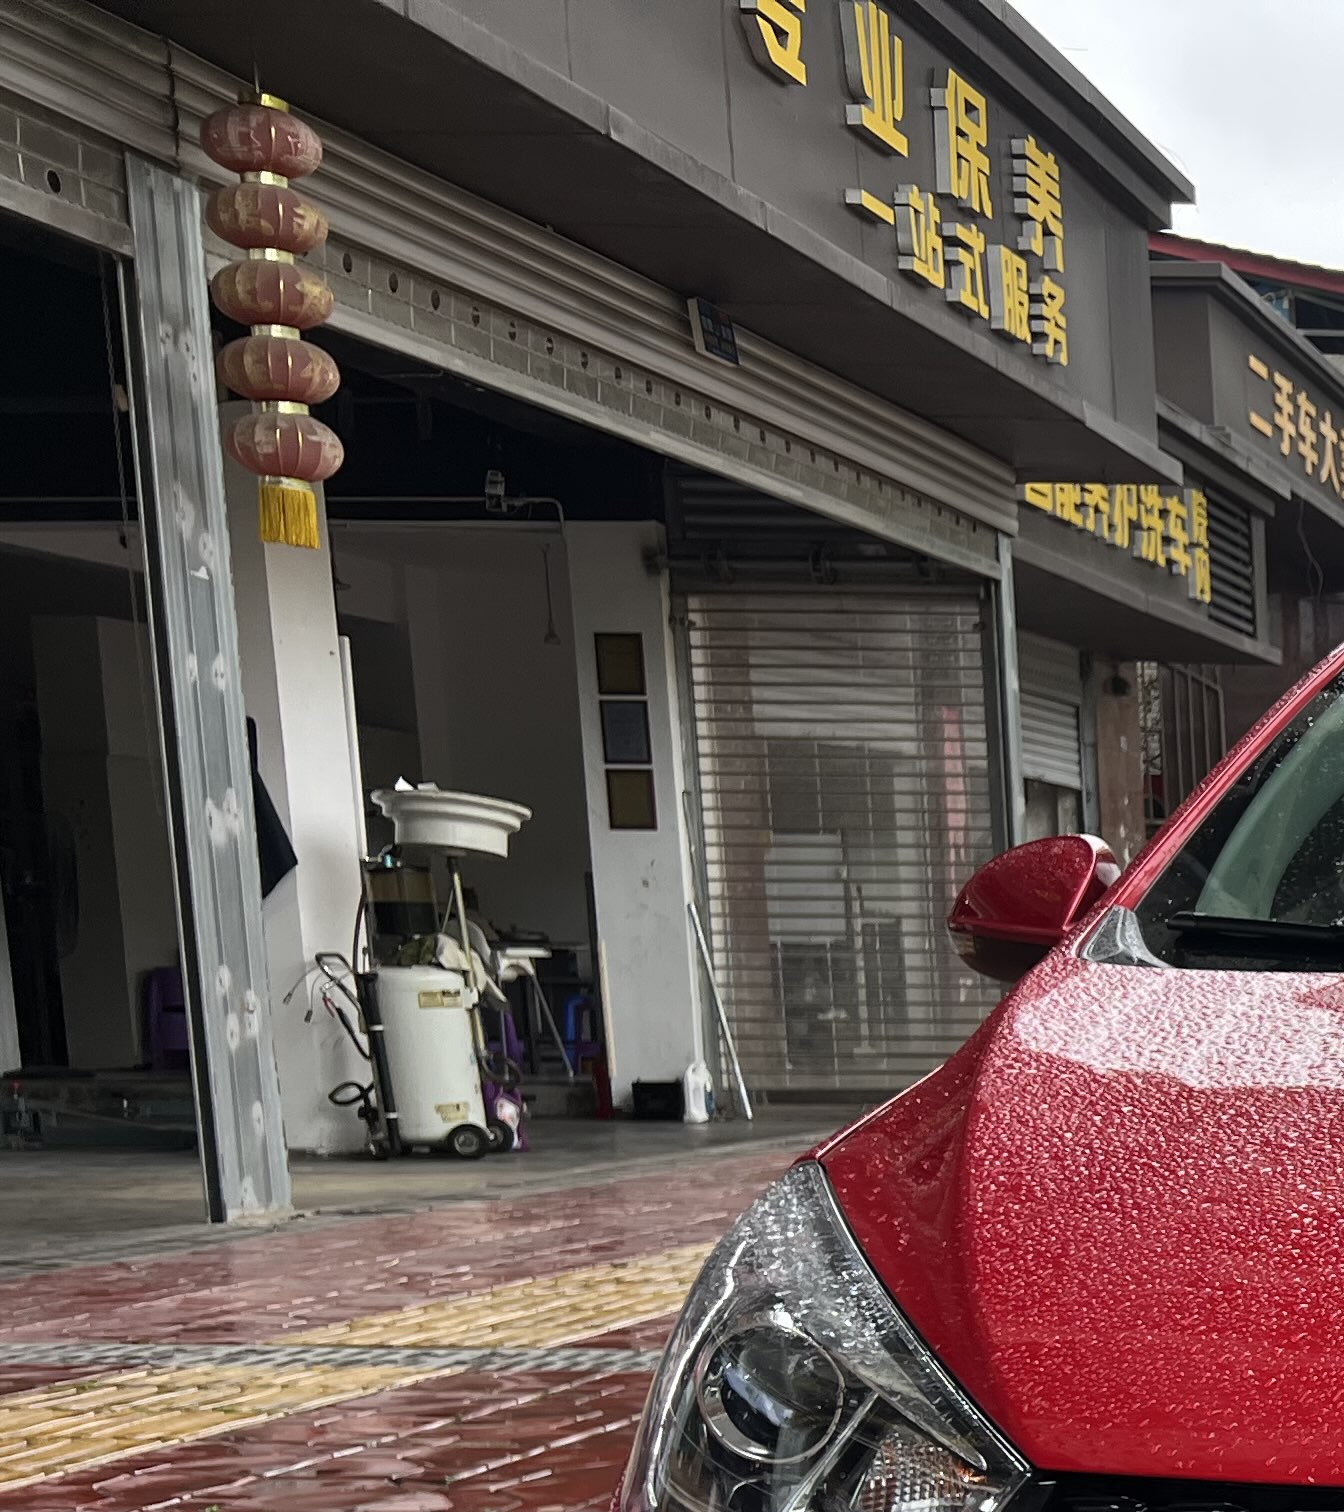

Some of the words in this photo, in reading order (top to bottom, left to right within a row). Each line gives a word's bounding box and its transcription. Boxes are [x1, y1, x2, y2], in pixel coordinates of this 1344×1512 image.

[860, 184, 1069, 367] 一站式服务
